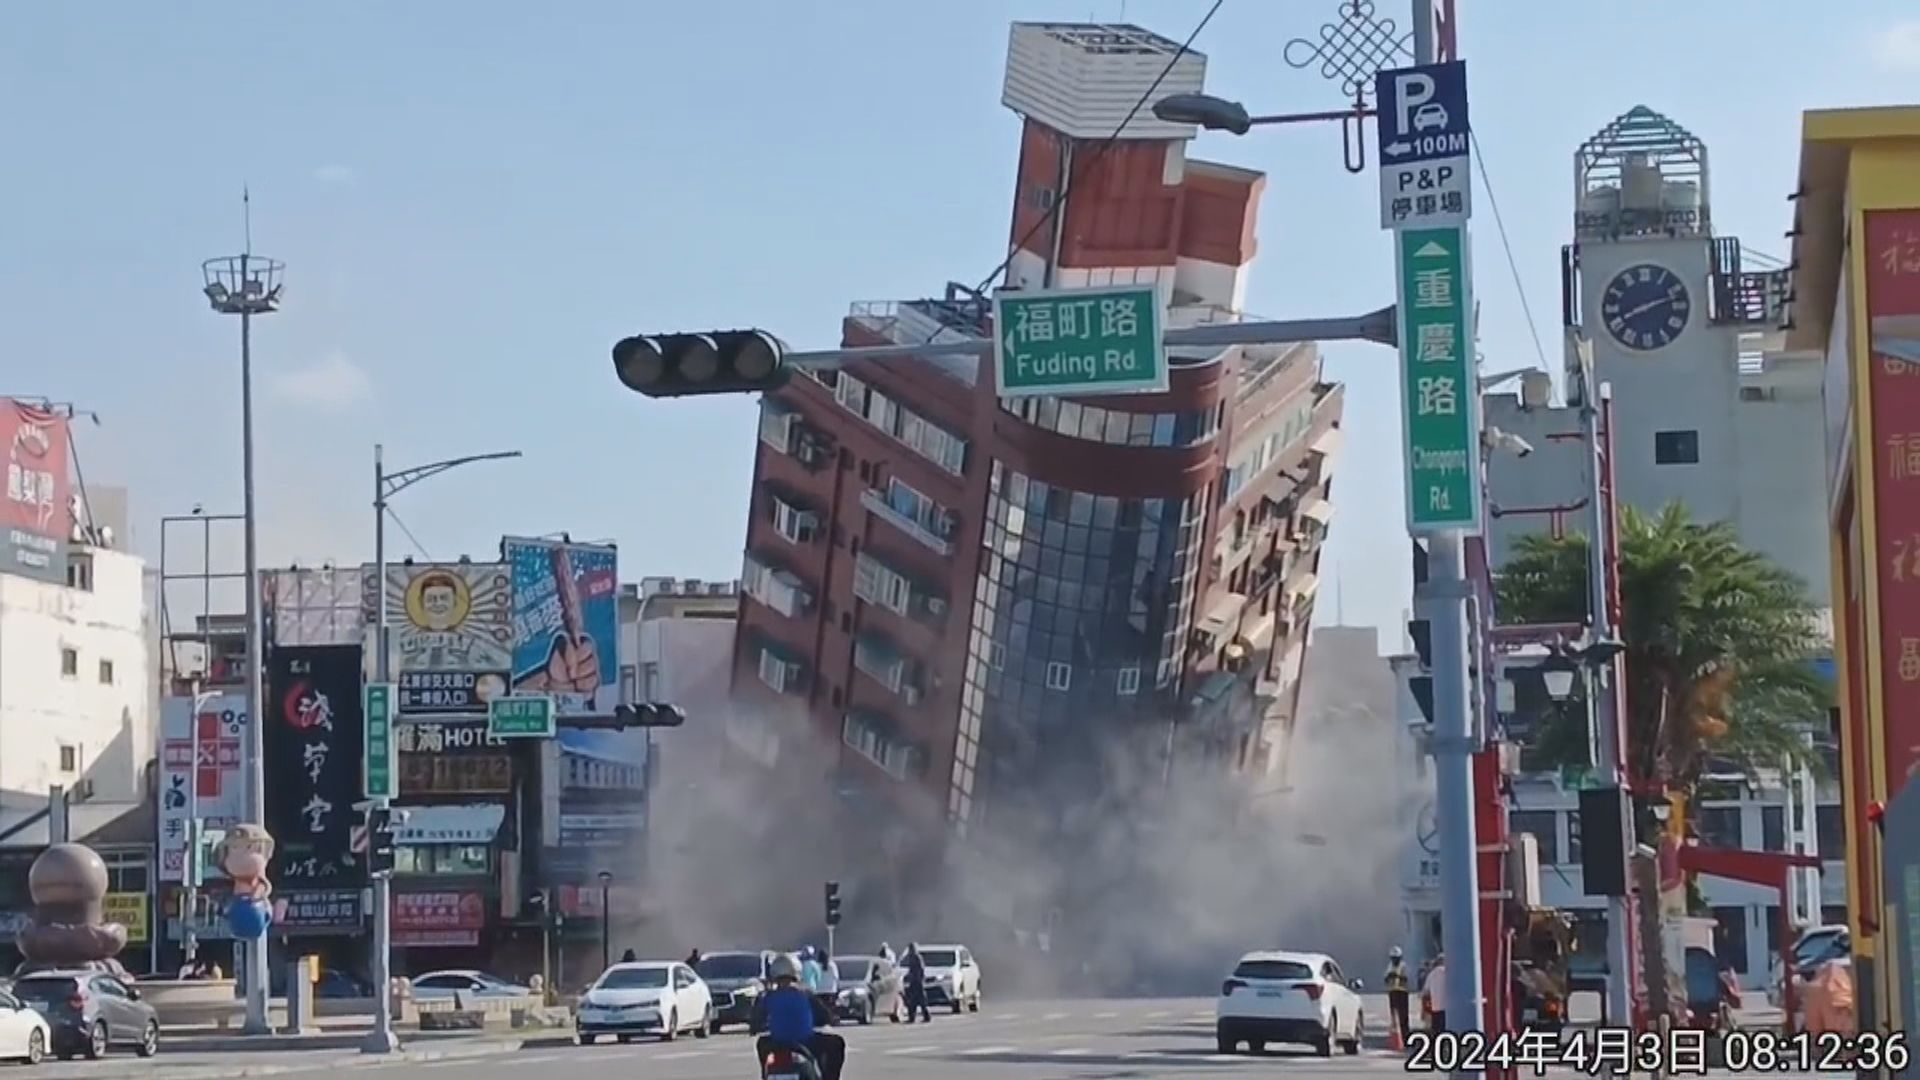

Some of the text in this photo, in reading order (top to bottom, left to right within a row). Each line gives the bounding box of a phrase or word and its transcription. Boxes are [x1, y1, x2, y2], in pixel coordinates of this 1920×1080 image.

[1395, 74, 1435, 135] P
[1413, 134, 1466, 155] 100M
[1398, 166, 1452, 191] P&P
[1392, 191, 1462, 221] 停車場
[1016, 299, 1137, 342] 福町路
[1414, 268, 1457, 415] 重慶路
[1017, 352, 1096, 379] Fuding
[445, 727, 507, 746] HOTEL
